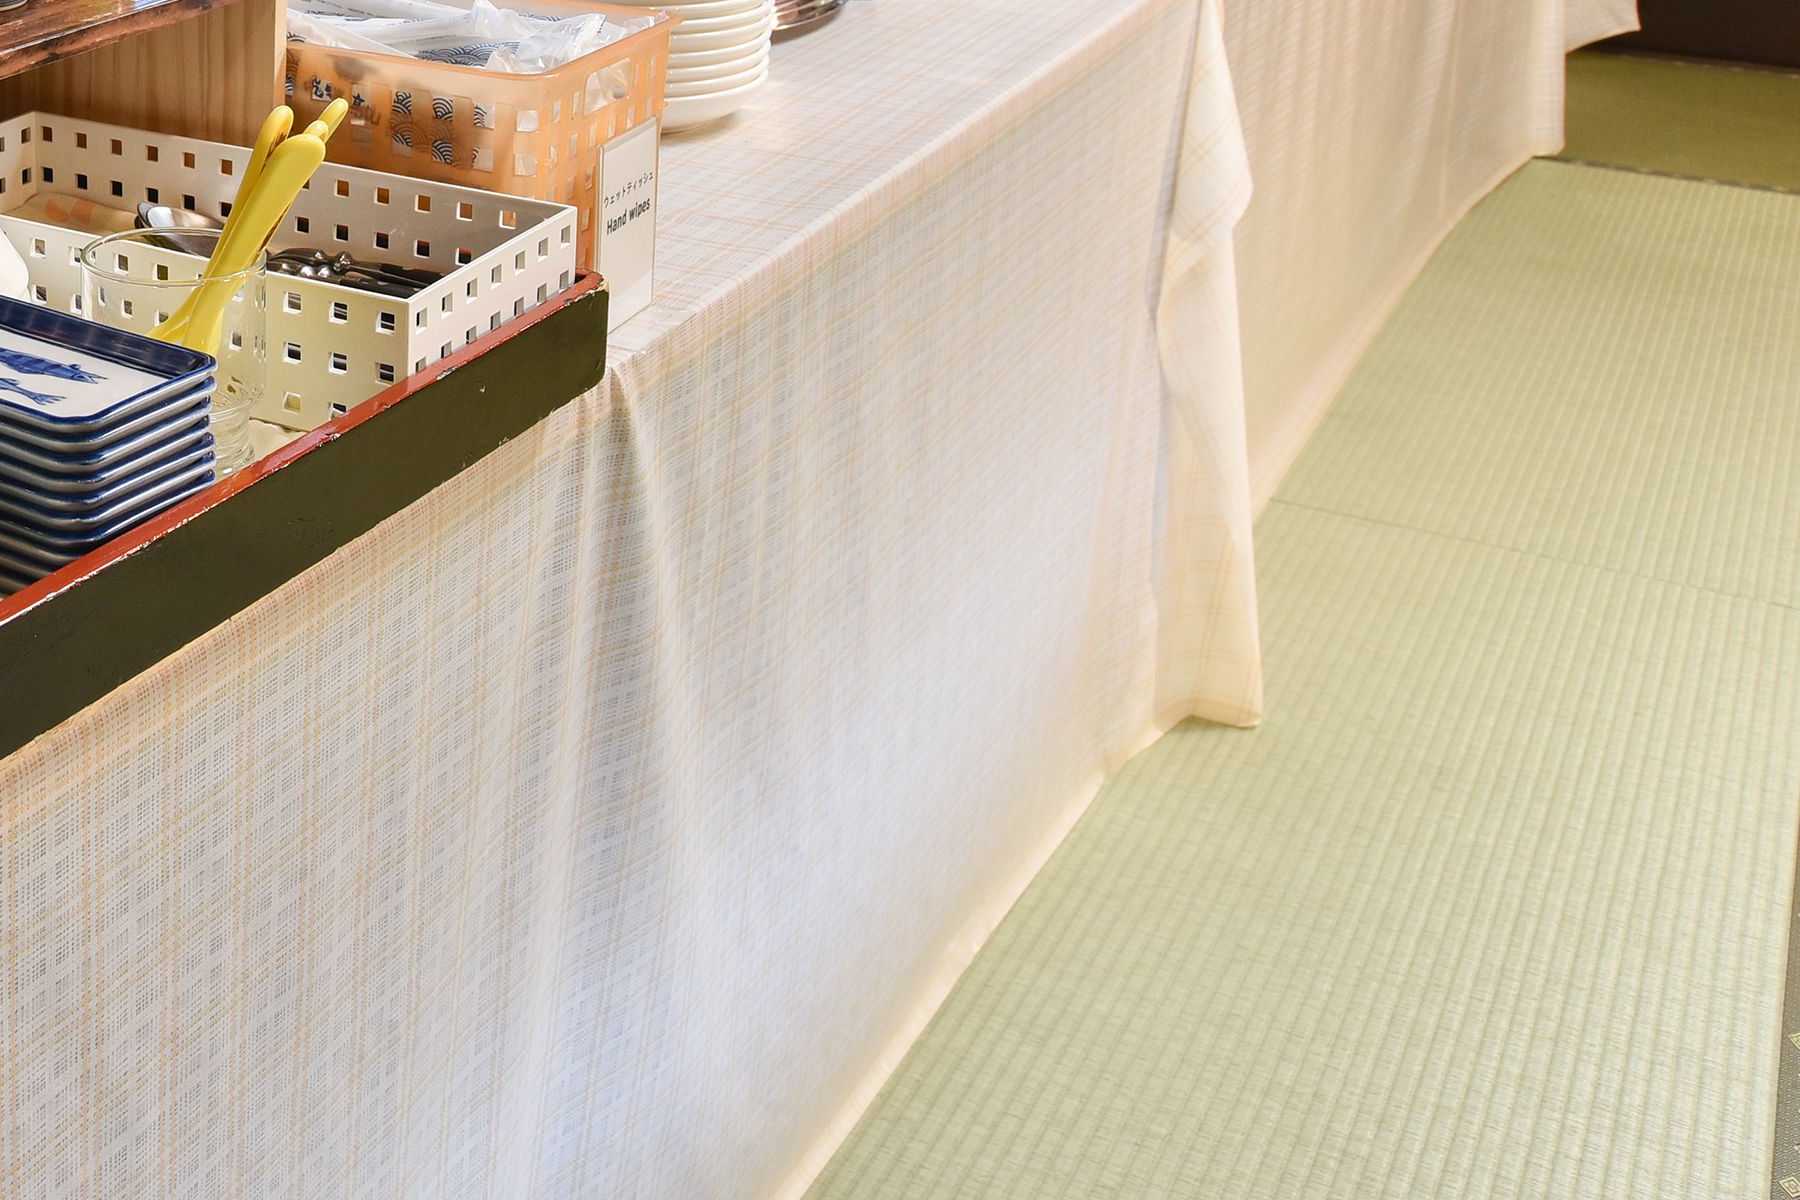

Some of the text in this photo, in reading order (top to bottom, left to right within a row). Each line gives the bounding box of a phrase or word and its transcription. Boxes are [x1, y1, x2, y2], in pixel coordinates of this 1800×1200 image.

[603, 172, 654, 209] ウェットティッシュ
[606, 198, 651, 236] Hand wipes
